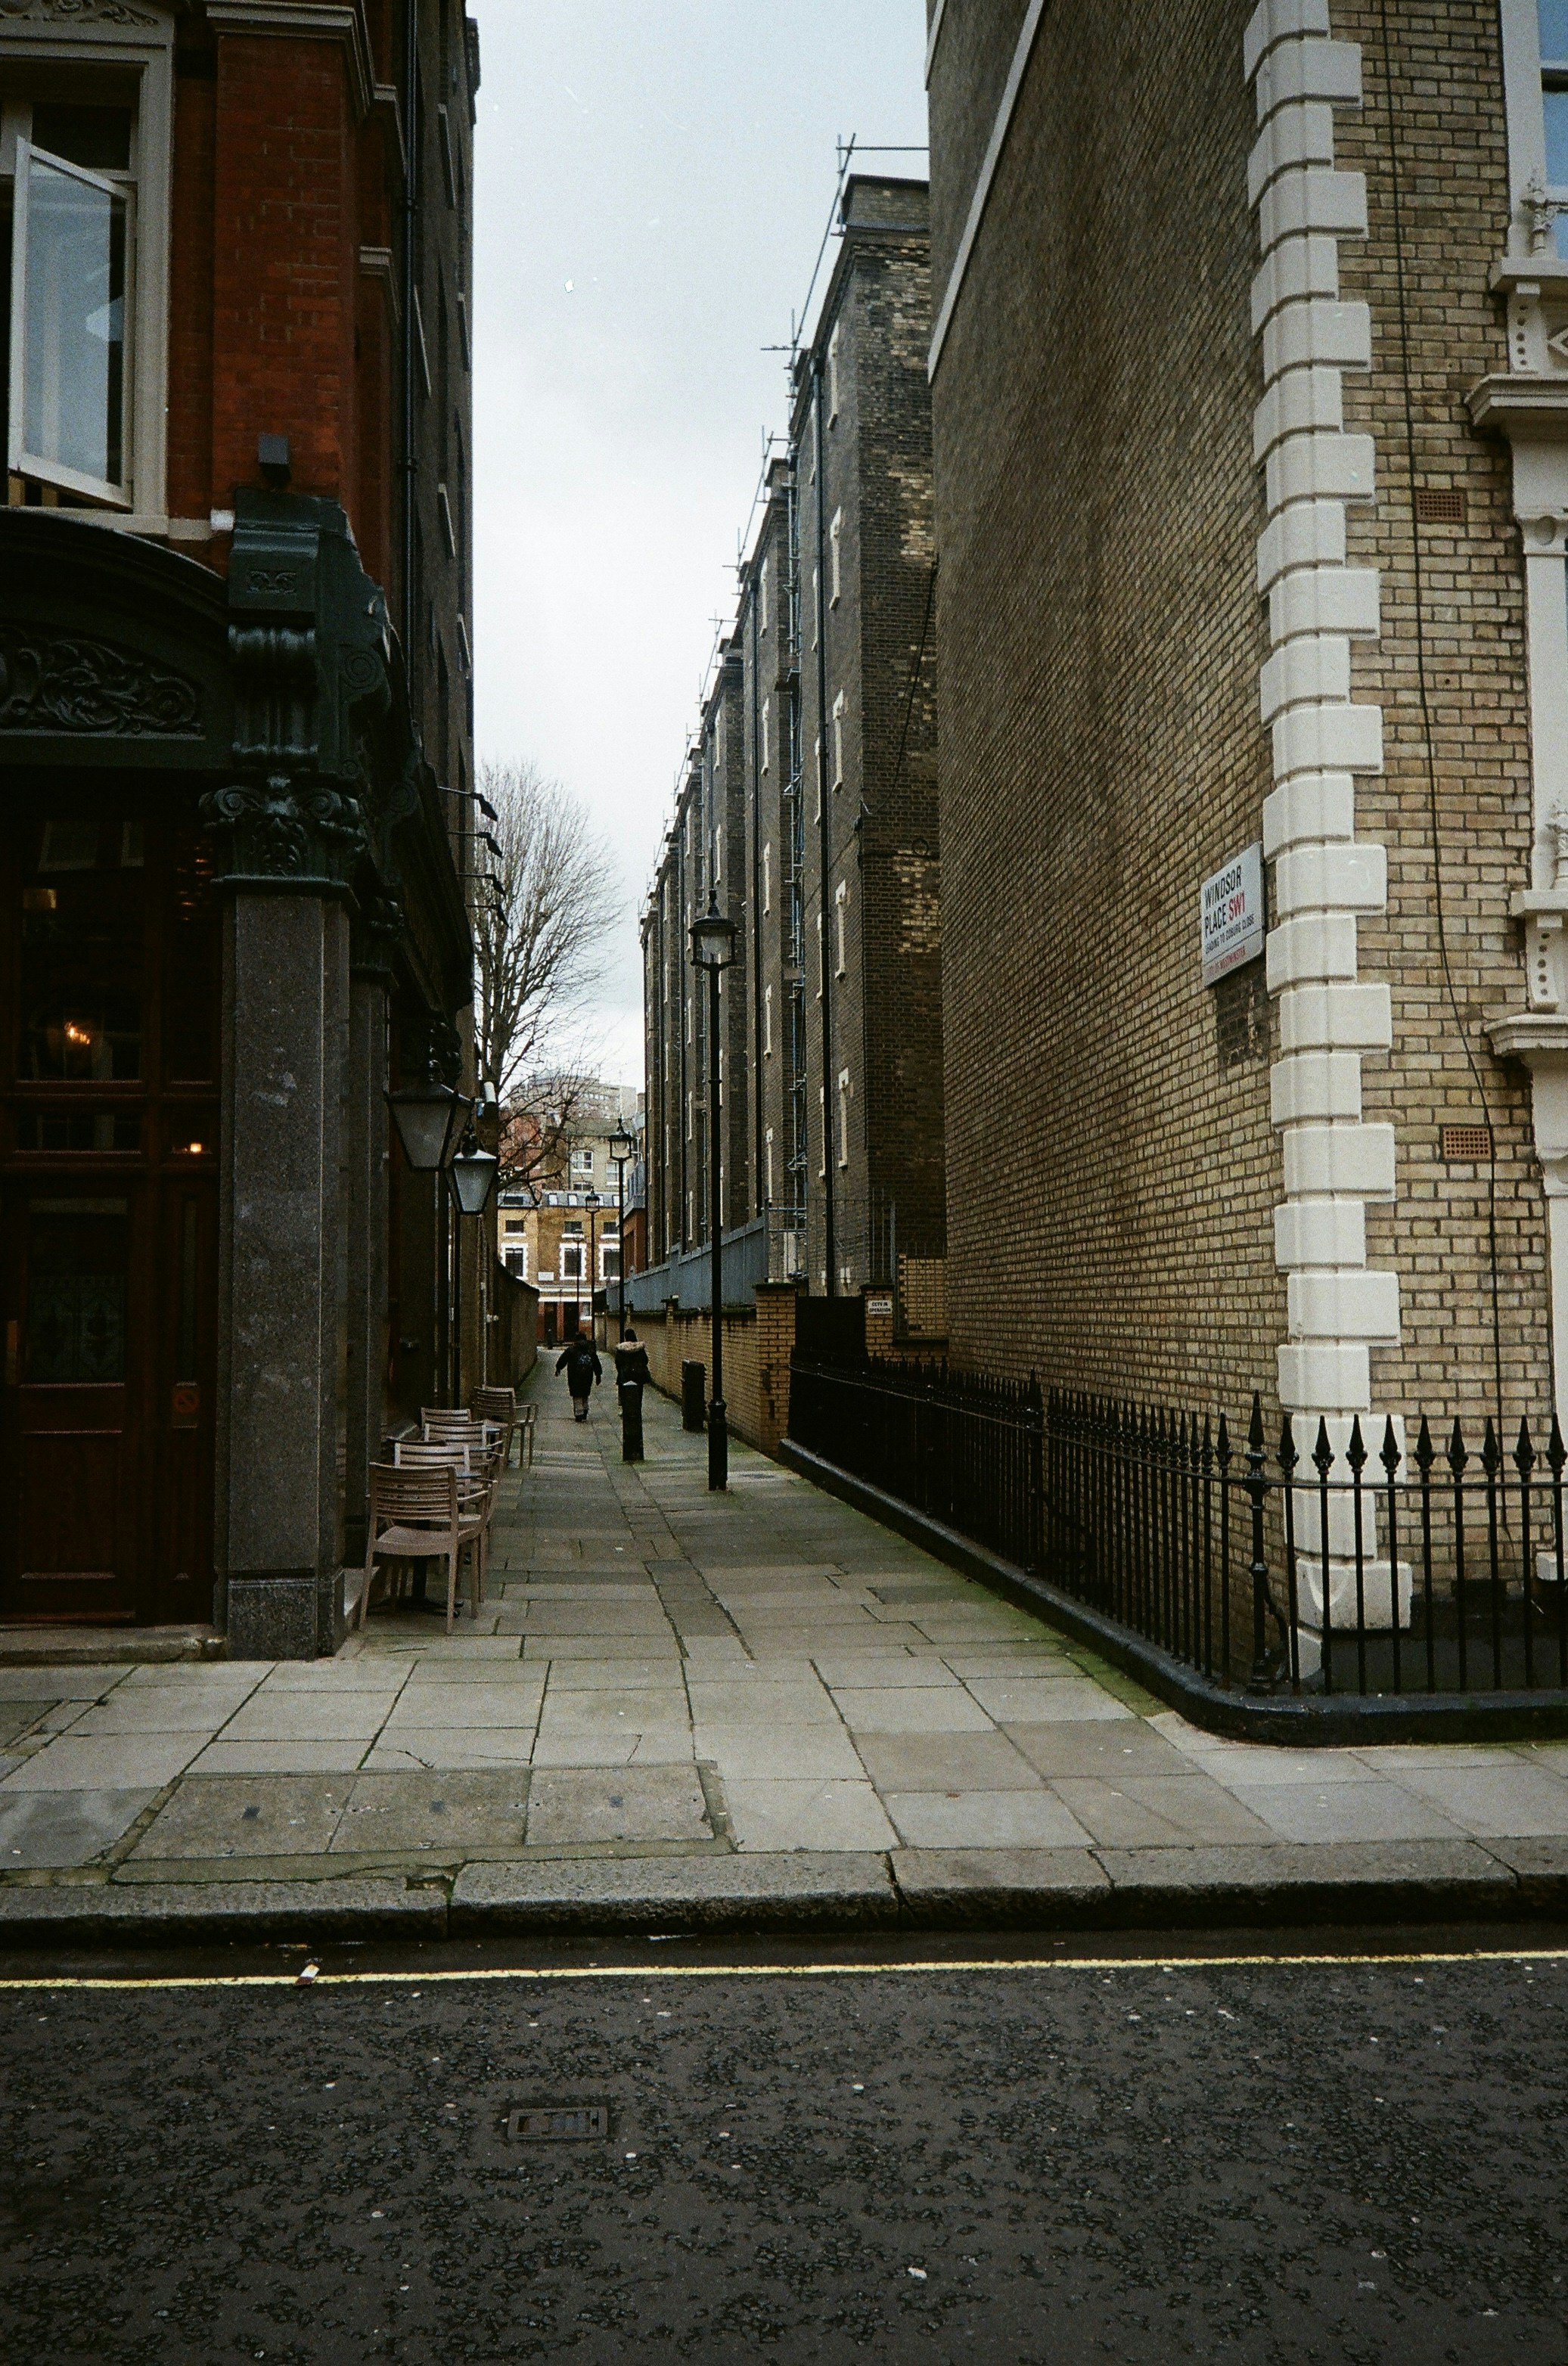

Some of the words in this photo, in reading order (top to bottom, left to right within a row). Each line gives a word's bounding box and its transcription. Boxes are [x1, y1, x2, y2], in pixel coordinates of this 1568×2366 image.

[1205, 865, 1241, 910] WINDSOR
[1204, 903, 1226, 938] PLACE
[1229, 890, 1245, 921] SW1
[1205, 936, 1219, 955] LEADING
[1219, 933, 1225, 943] TO
[1242, 913, 1254, 930] CLOSE
